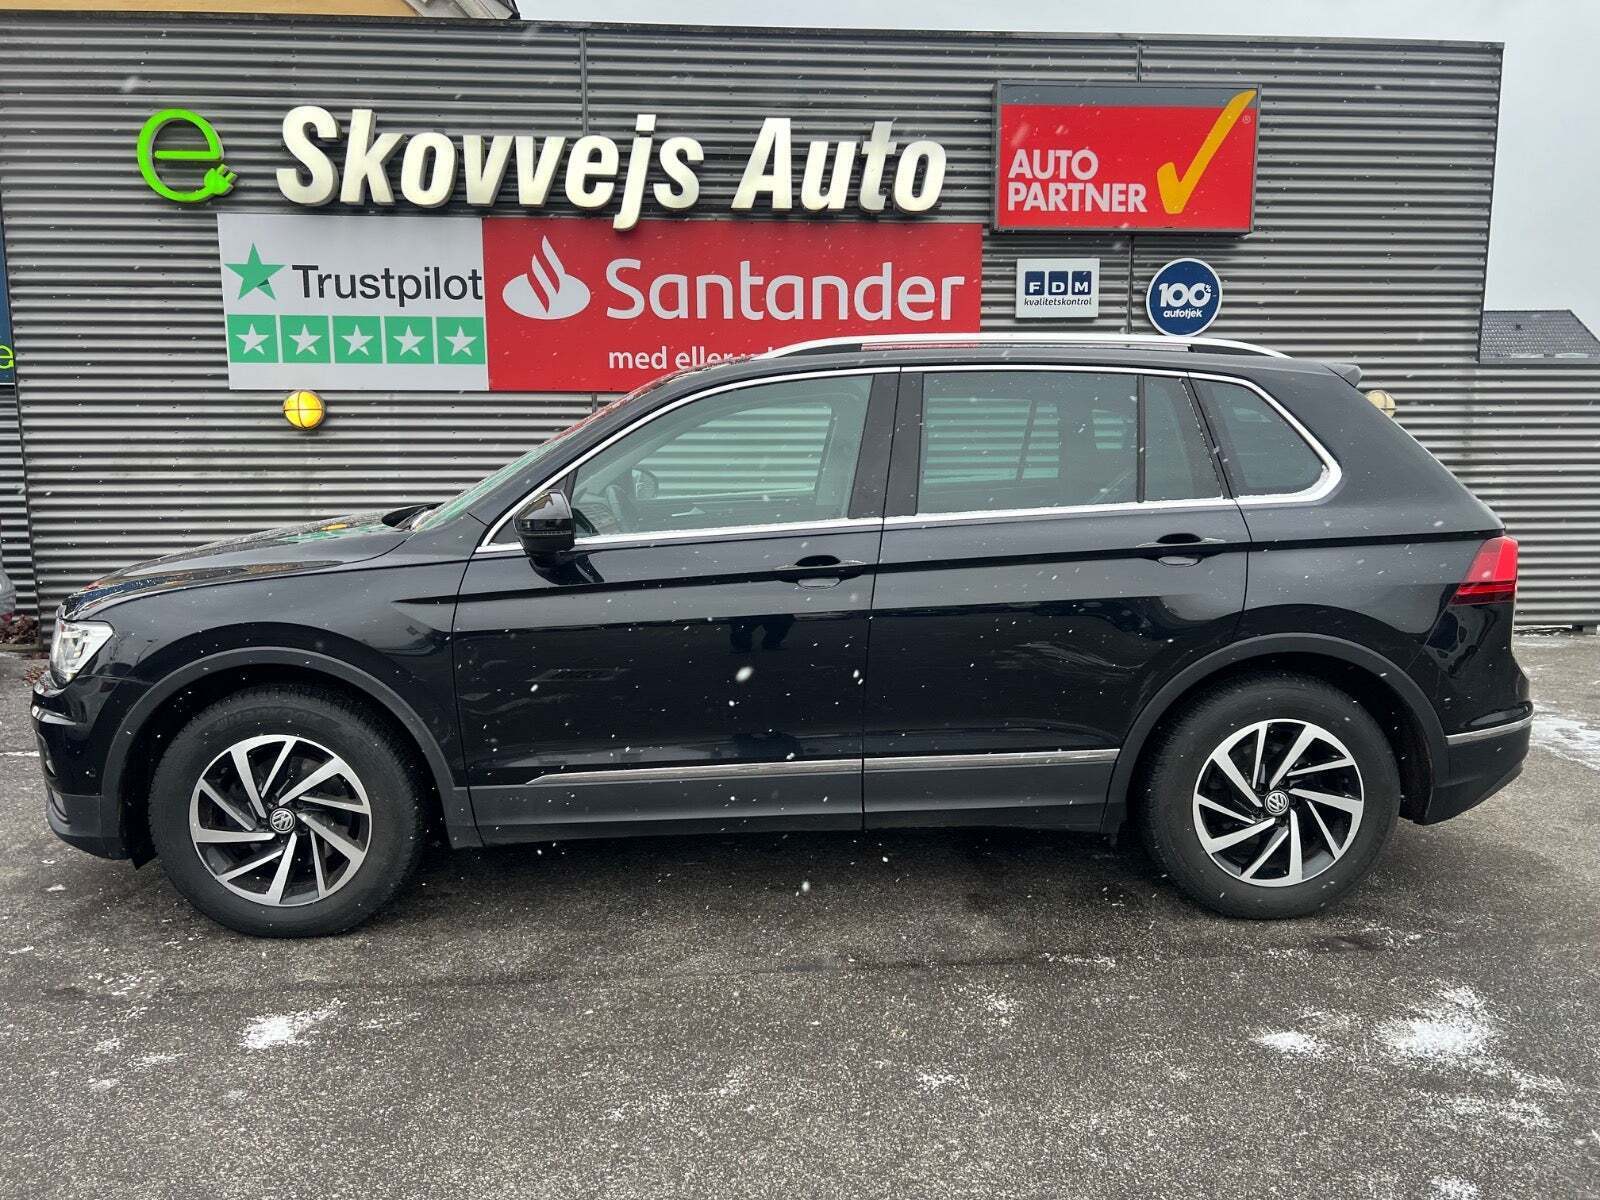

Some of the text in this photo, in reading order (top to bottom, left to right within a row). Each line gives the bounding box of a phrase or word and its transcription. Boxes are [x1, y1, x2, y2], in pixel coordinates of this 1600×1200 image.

[276, 106, 948, 232] Skovvejs Auto
[1008, 149, 1099, 181] AUTO
[1007, 182, 1148, 213] PARTNER
[291, 264, 484, 308] Trustpilot
[606, 258, 966, 322] Santander
[1024, 297, 1092, 307] kvalitetskontrol
[608, 346, 668, 370] med
